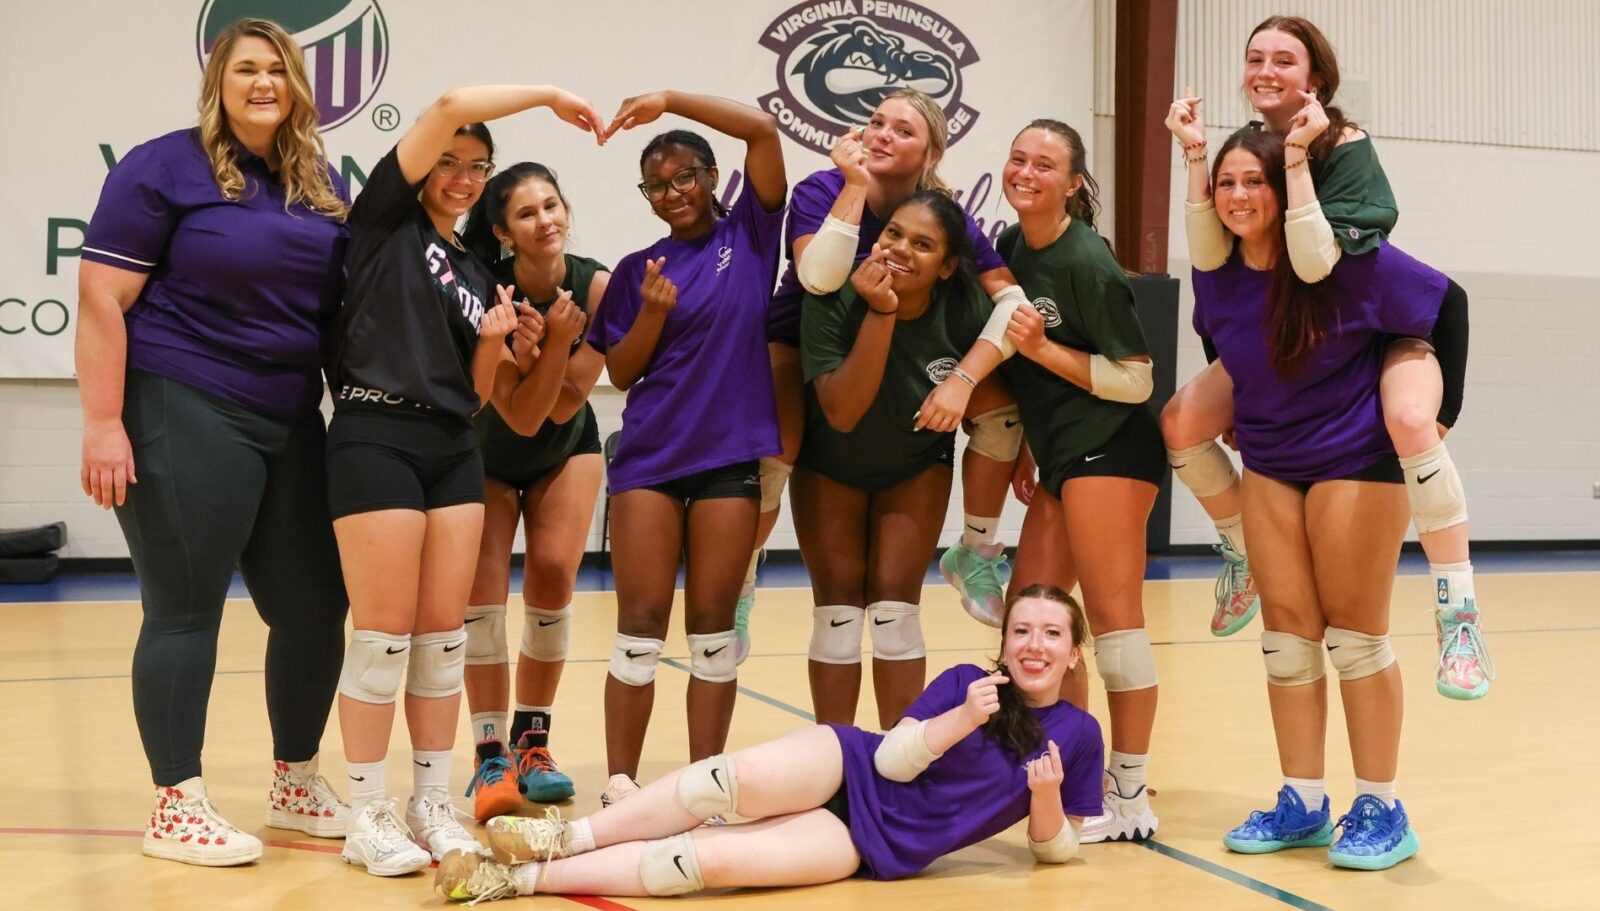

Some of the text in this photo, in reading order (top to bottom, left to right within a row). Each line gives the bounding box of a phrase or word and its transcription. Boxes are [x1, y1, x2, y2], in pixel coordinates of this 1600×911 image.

[769, 0, 966, 60] VIRGINIA PENINSULA
[768, 97, 838, 150] COMMU
